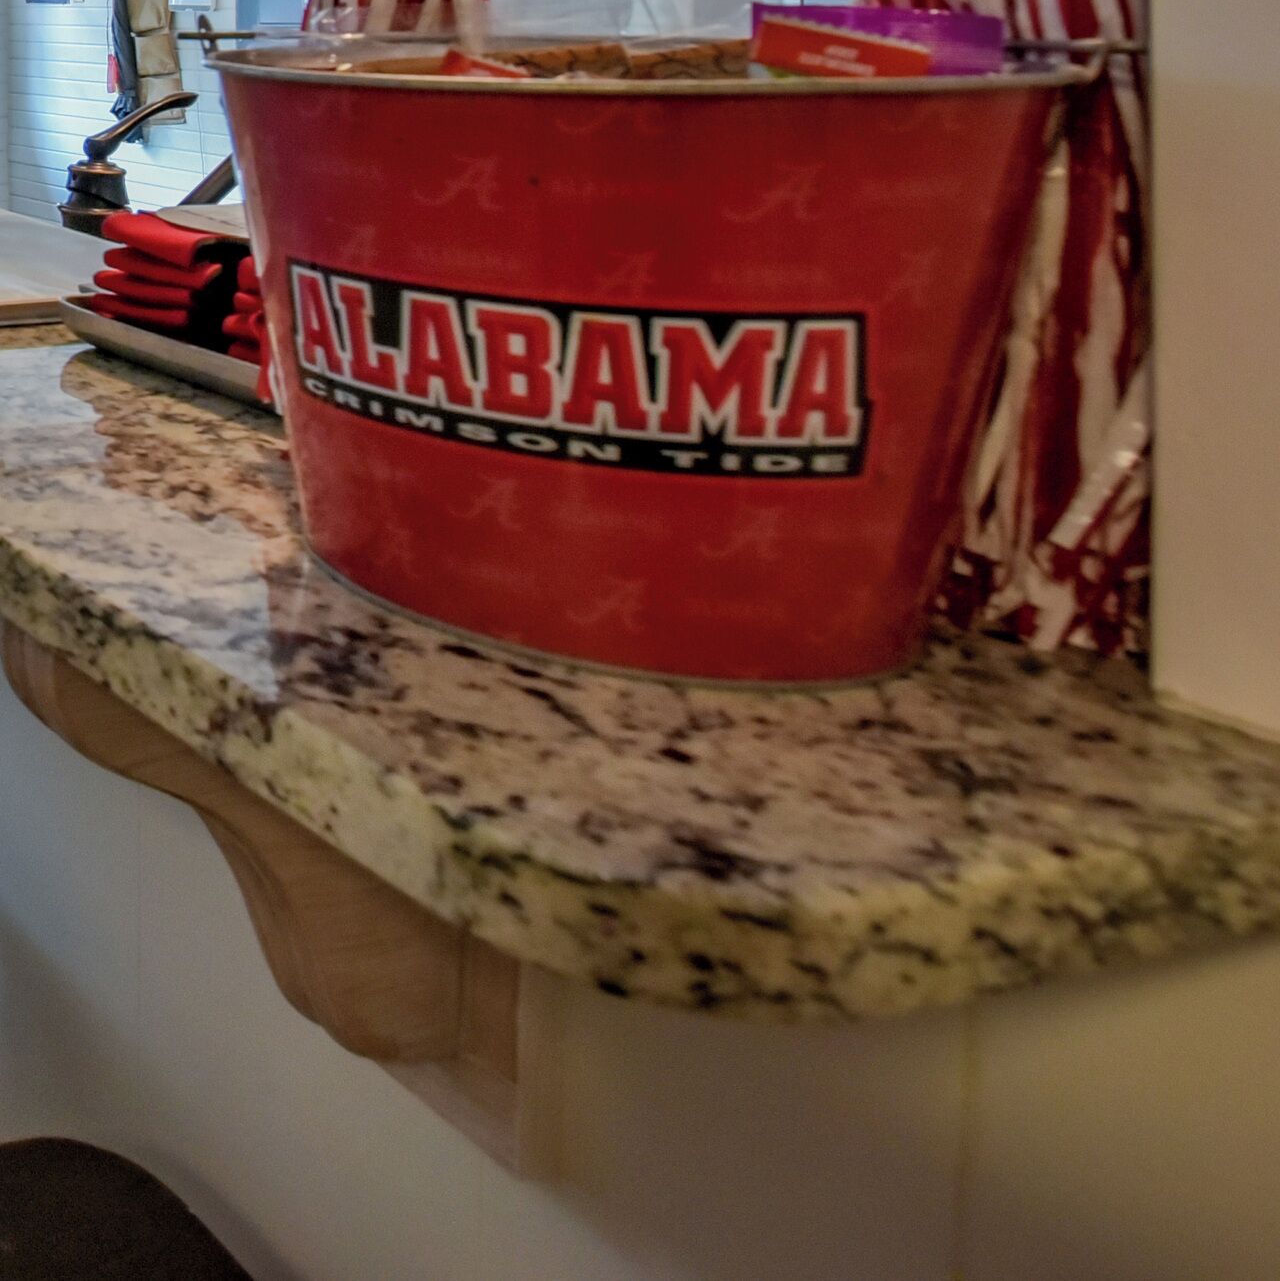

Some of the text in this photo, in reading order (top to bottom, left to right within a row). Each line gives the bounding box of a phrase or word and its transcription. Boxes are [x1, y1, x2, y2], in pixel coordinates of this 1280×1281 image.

[291, 264, 863, 448] ALABAMA
[304, 375, 851, 474] CRIMSON TIDE
